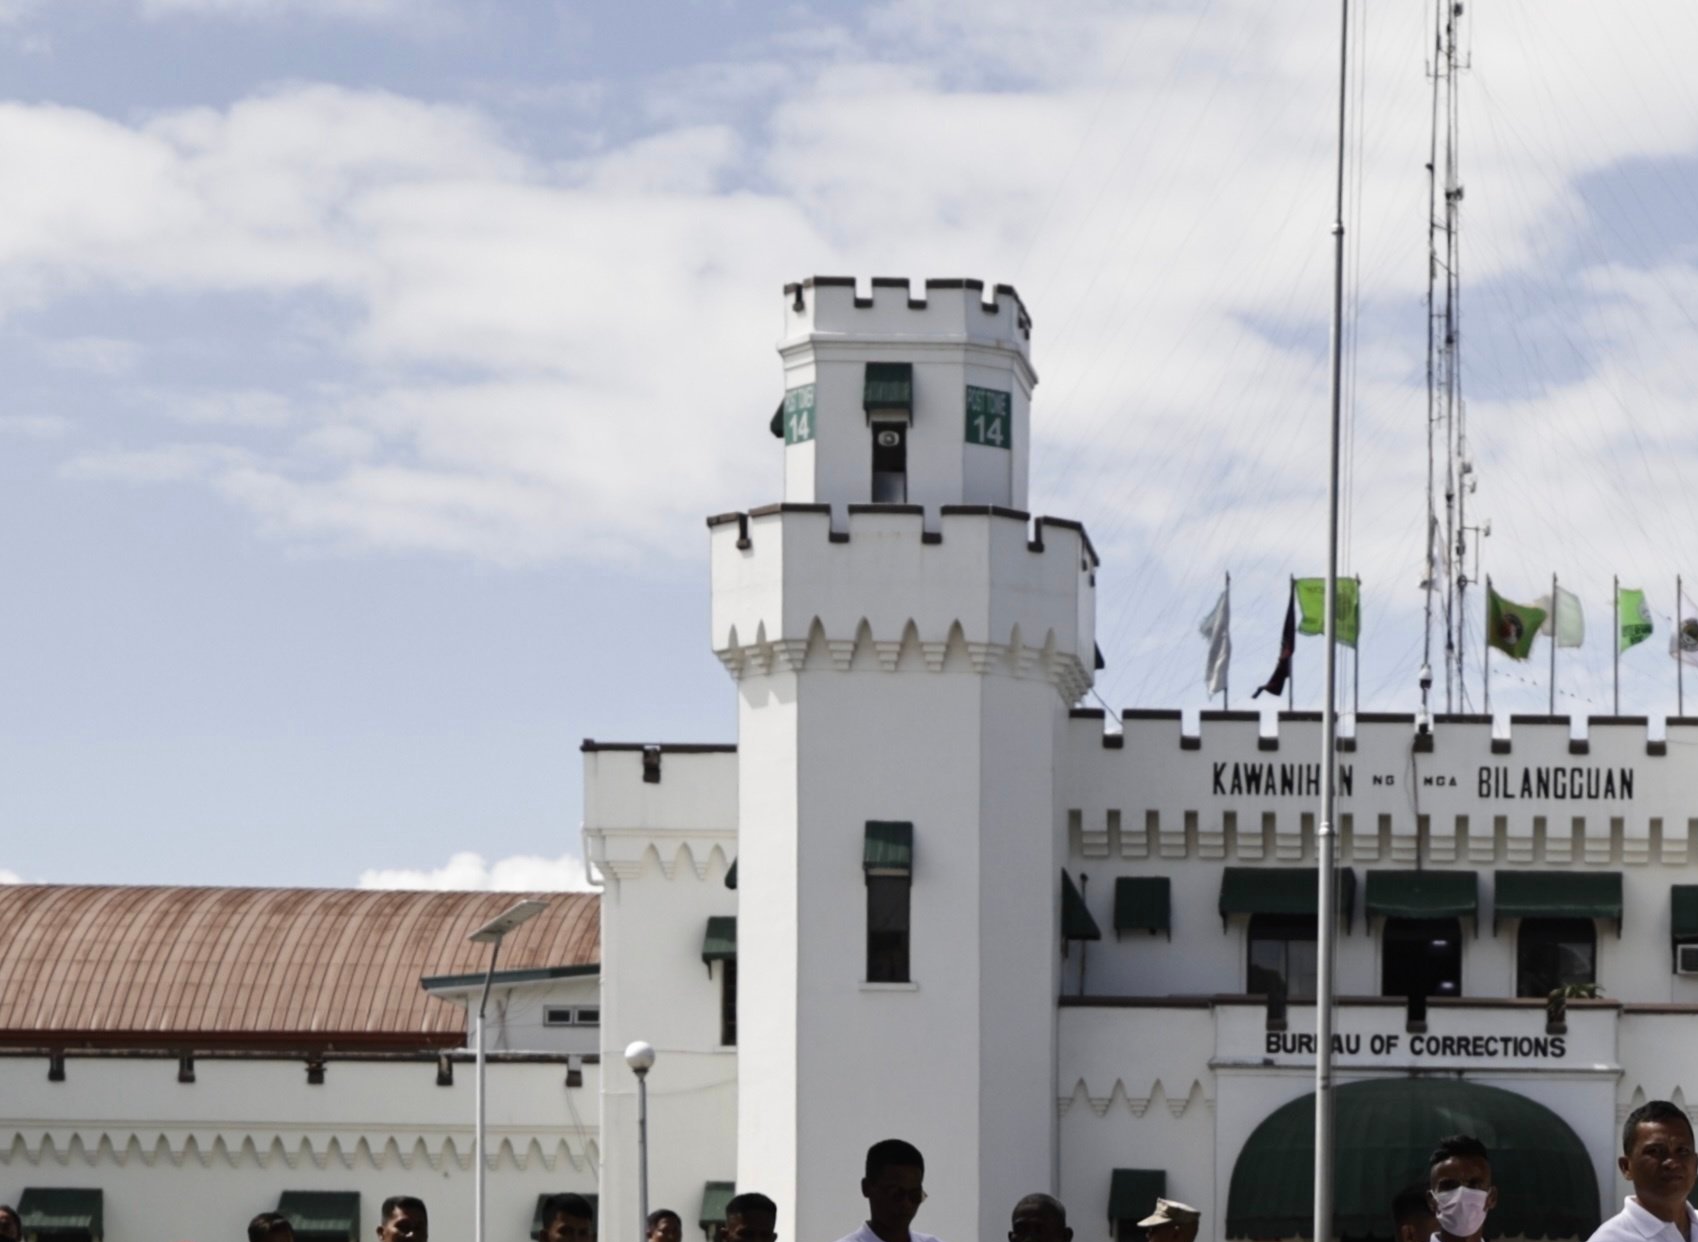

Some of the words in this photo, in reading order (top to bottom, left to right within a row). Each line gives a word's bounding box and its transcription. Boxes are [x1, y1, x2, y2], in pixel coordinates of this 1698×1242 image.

[789, 410, 810, 442] 14
[973, 414, 1004, 446] 14
[1213, 762, 1353, 797] KAWANIHN
[1373, 775, 1395, 786] NG
[1424, 776, 1458, 787] MGA
[1478, 766, 1634, 799] BILANGGUAN
[1265, 1033, 1360, 1054] BURAU
[1370, 1035, 1399, 1055] OF
[1409, 1036, 1566, 1058] CORRECTIONS
